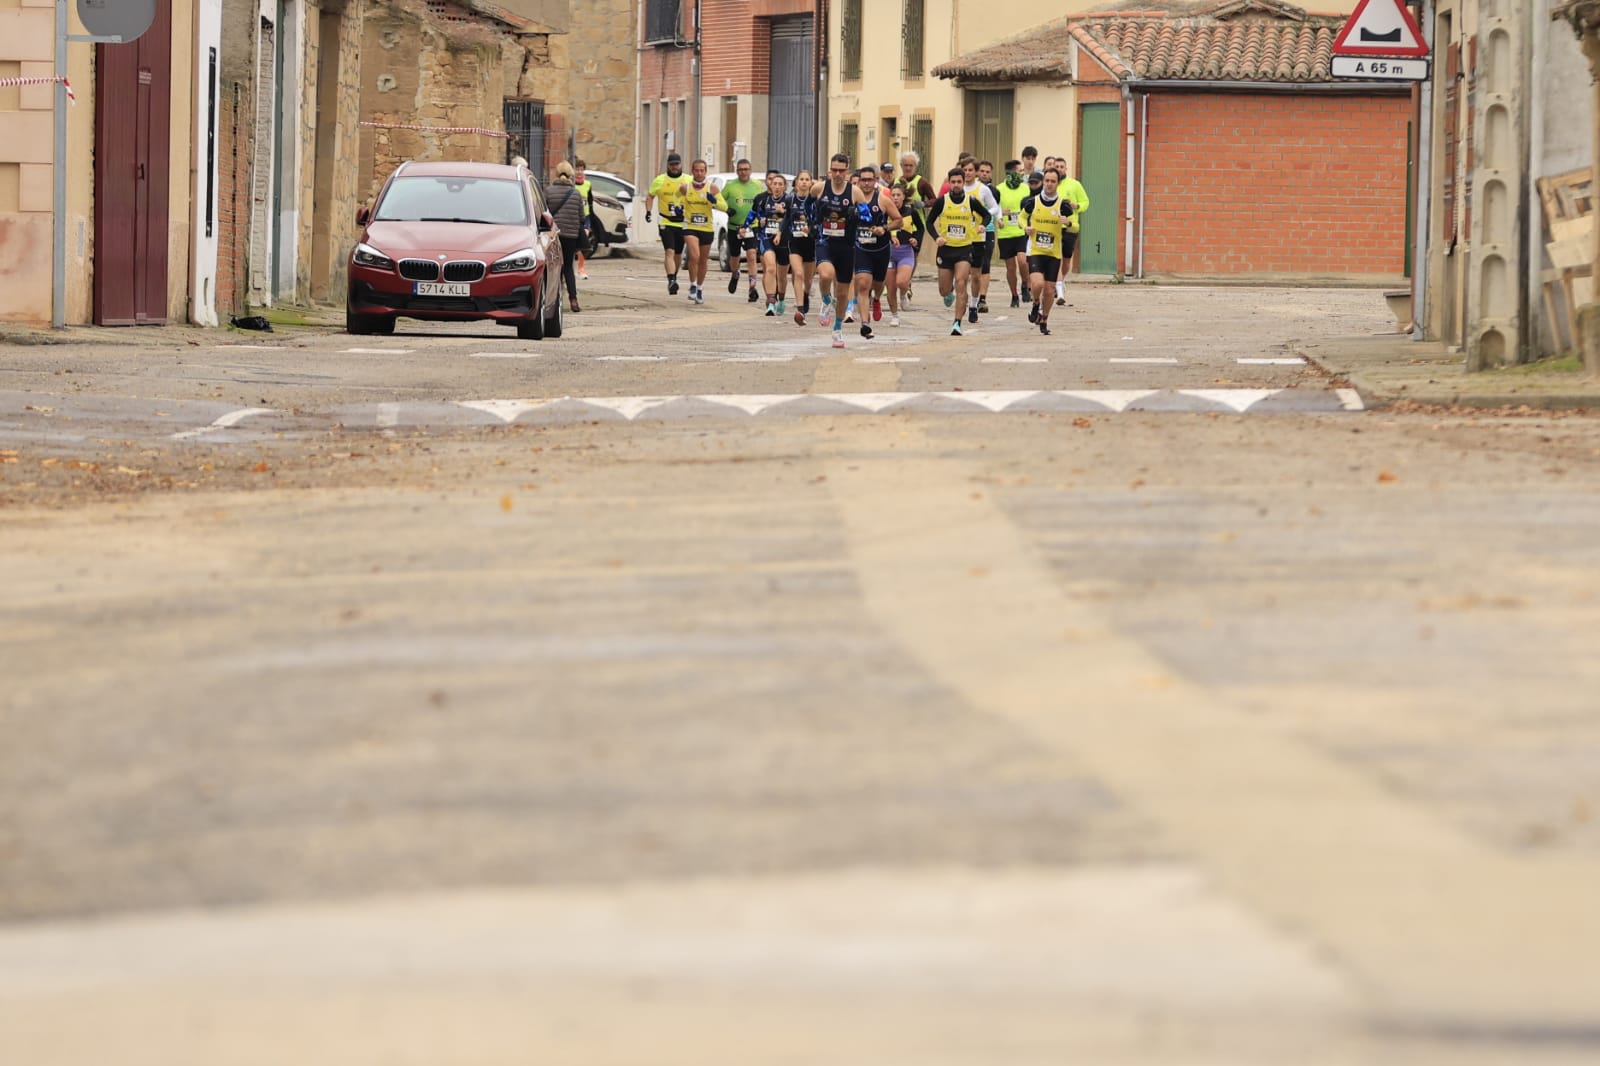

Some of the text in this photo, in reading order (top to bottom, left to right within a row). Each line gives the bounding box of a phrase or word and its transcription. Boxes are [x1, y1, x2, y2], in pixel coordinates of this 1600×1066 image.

[1356, 62, 1403, 74] A 65 m
[419, 284, 468, 295] 5714 KLL
